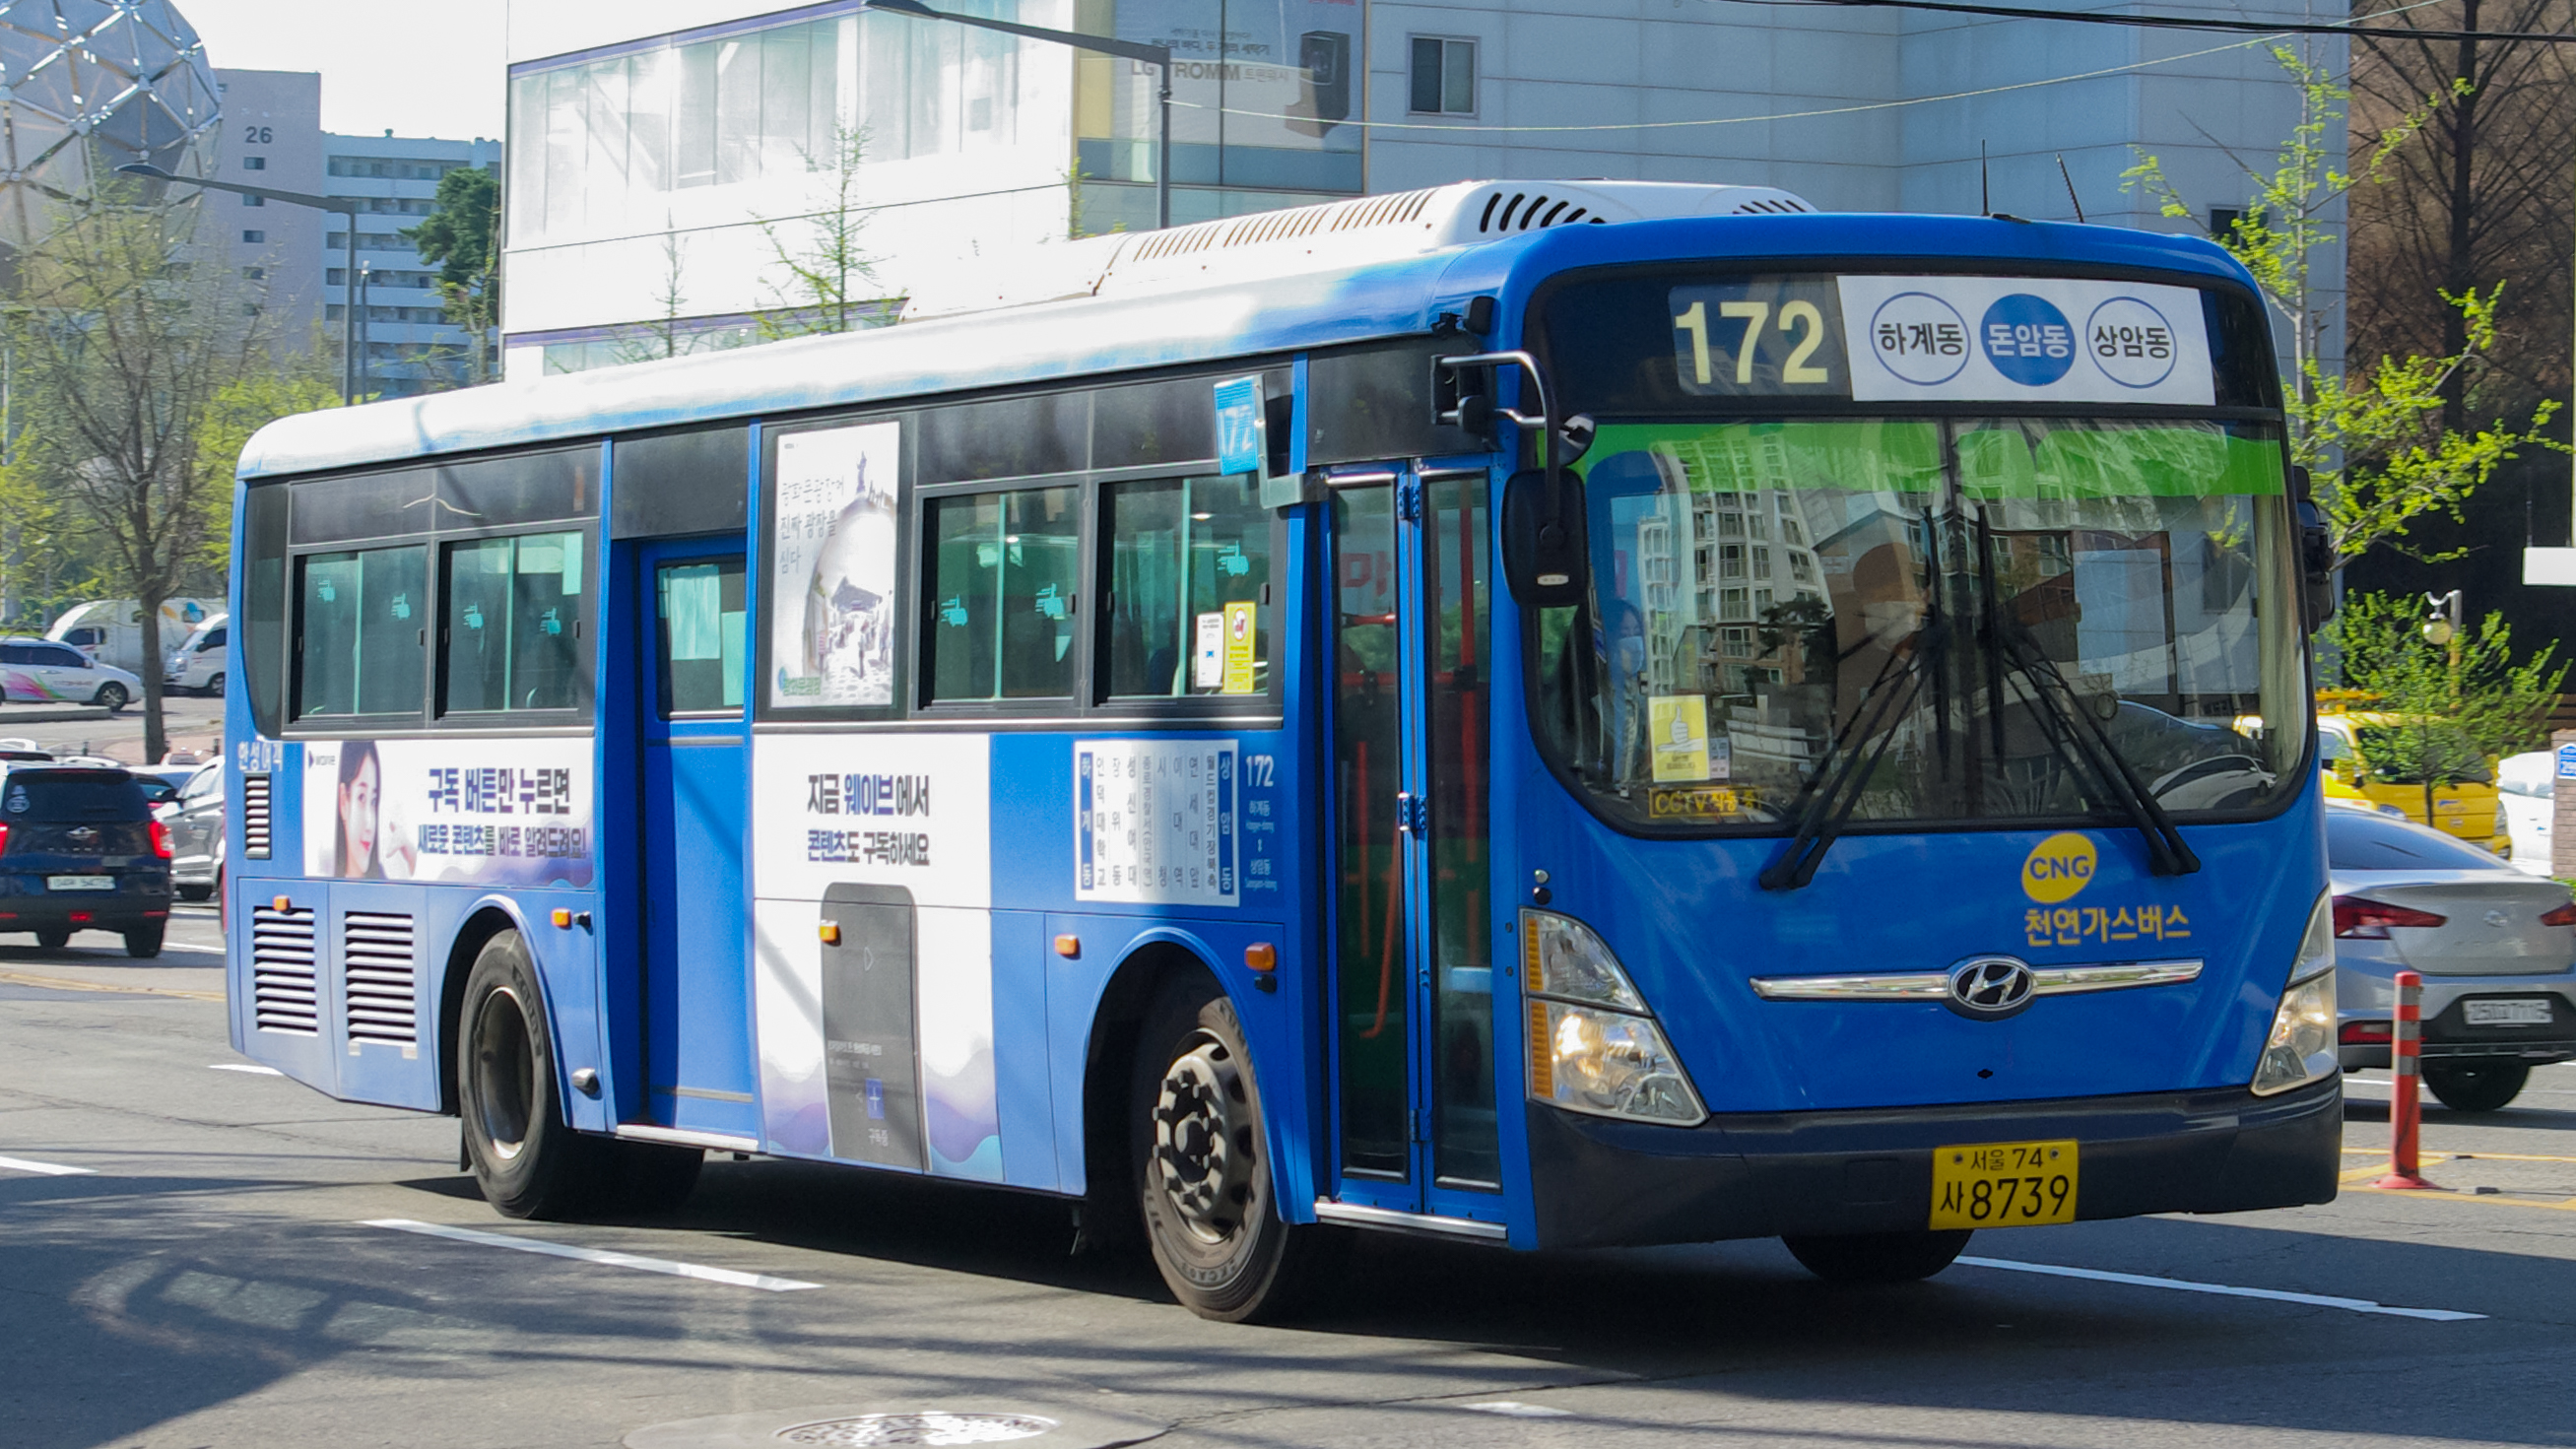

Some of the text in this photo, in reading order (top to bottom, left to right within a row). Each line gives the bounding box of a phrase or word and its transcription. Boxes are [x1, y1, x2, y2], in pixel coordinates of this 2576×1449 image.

[1131, 60, 1155, 77] LG
[1169, 62, 1241, 81] ROMM
[245, 126, 272, 144] 26
[1675, 300, 1829, 385] 172
[1879, 321, 1964, 358] 하계동
[1987, 323, 2070, 360] 돈암동
[2093, 324, 2171, 362] 상암동
[779, 545, 802, 574] 심다
[1245, 755, 1275, 787] 172
[428, 767, 571, 816] 구독 버튼만 누르면
[807, 773, 930, 817] 지금 웨이브에서
[1655, 790, 1707, 815] CCTV
[418, 823, 449, 855] 새로운
[452, 824, 495, 857] 콘텐츠를
[498, 825, 521, 857] 바로
[863, 831, 930, 867] 구독하세요
[2029, 855, 2090, 881] CNG
[2024, 904, 2192, 948] 천연가스버스
[1970, 1148, 2044, 1173] 서울 74
